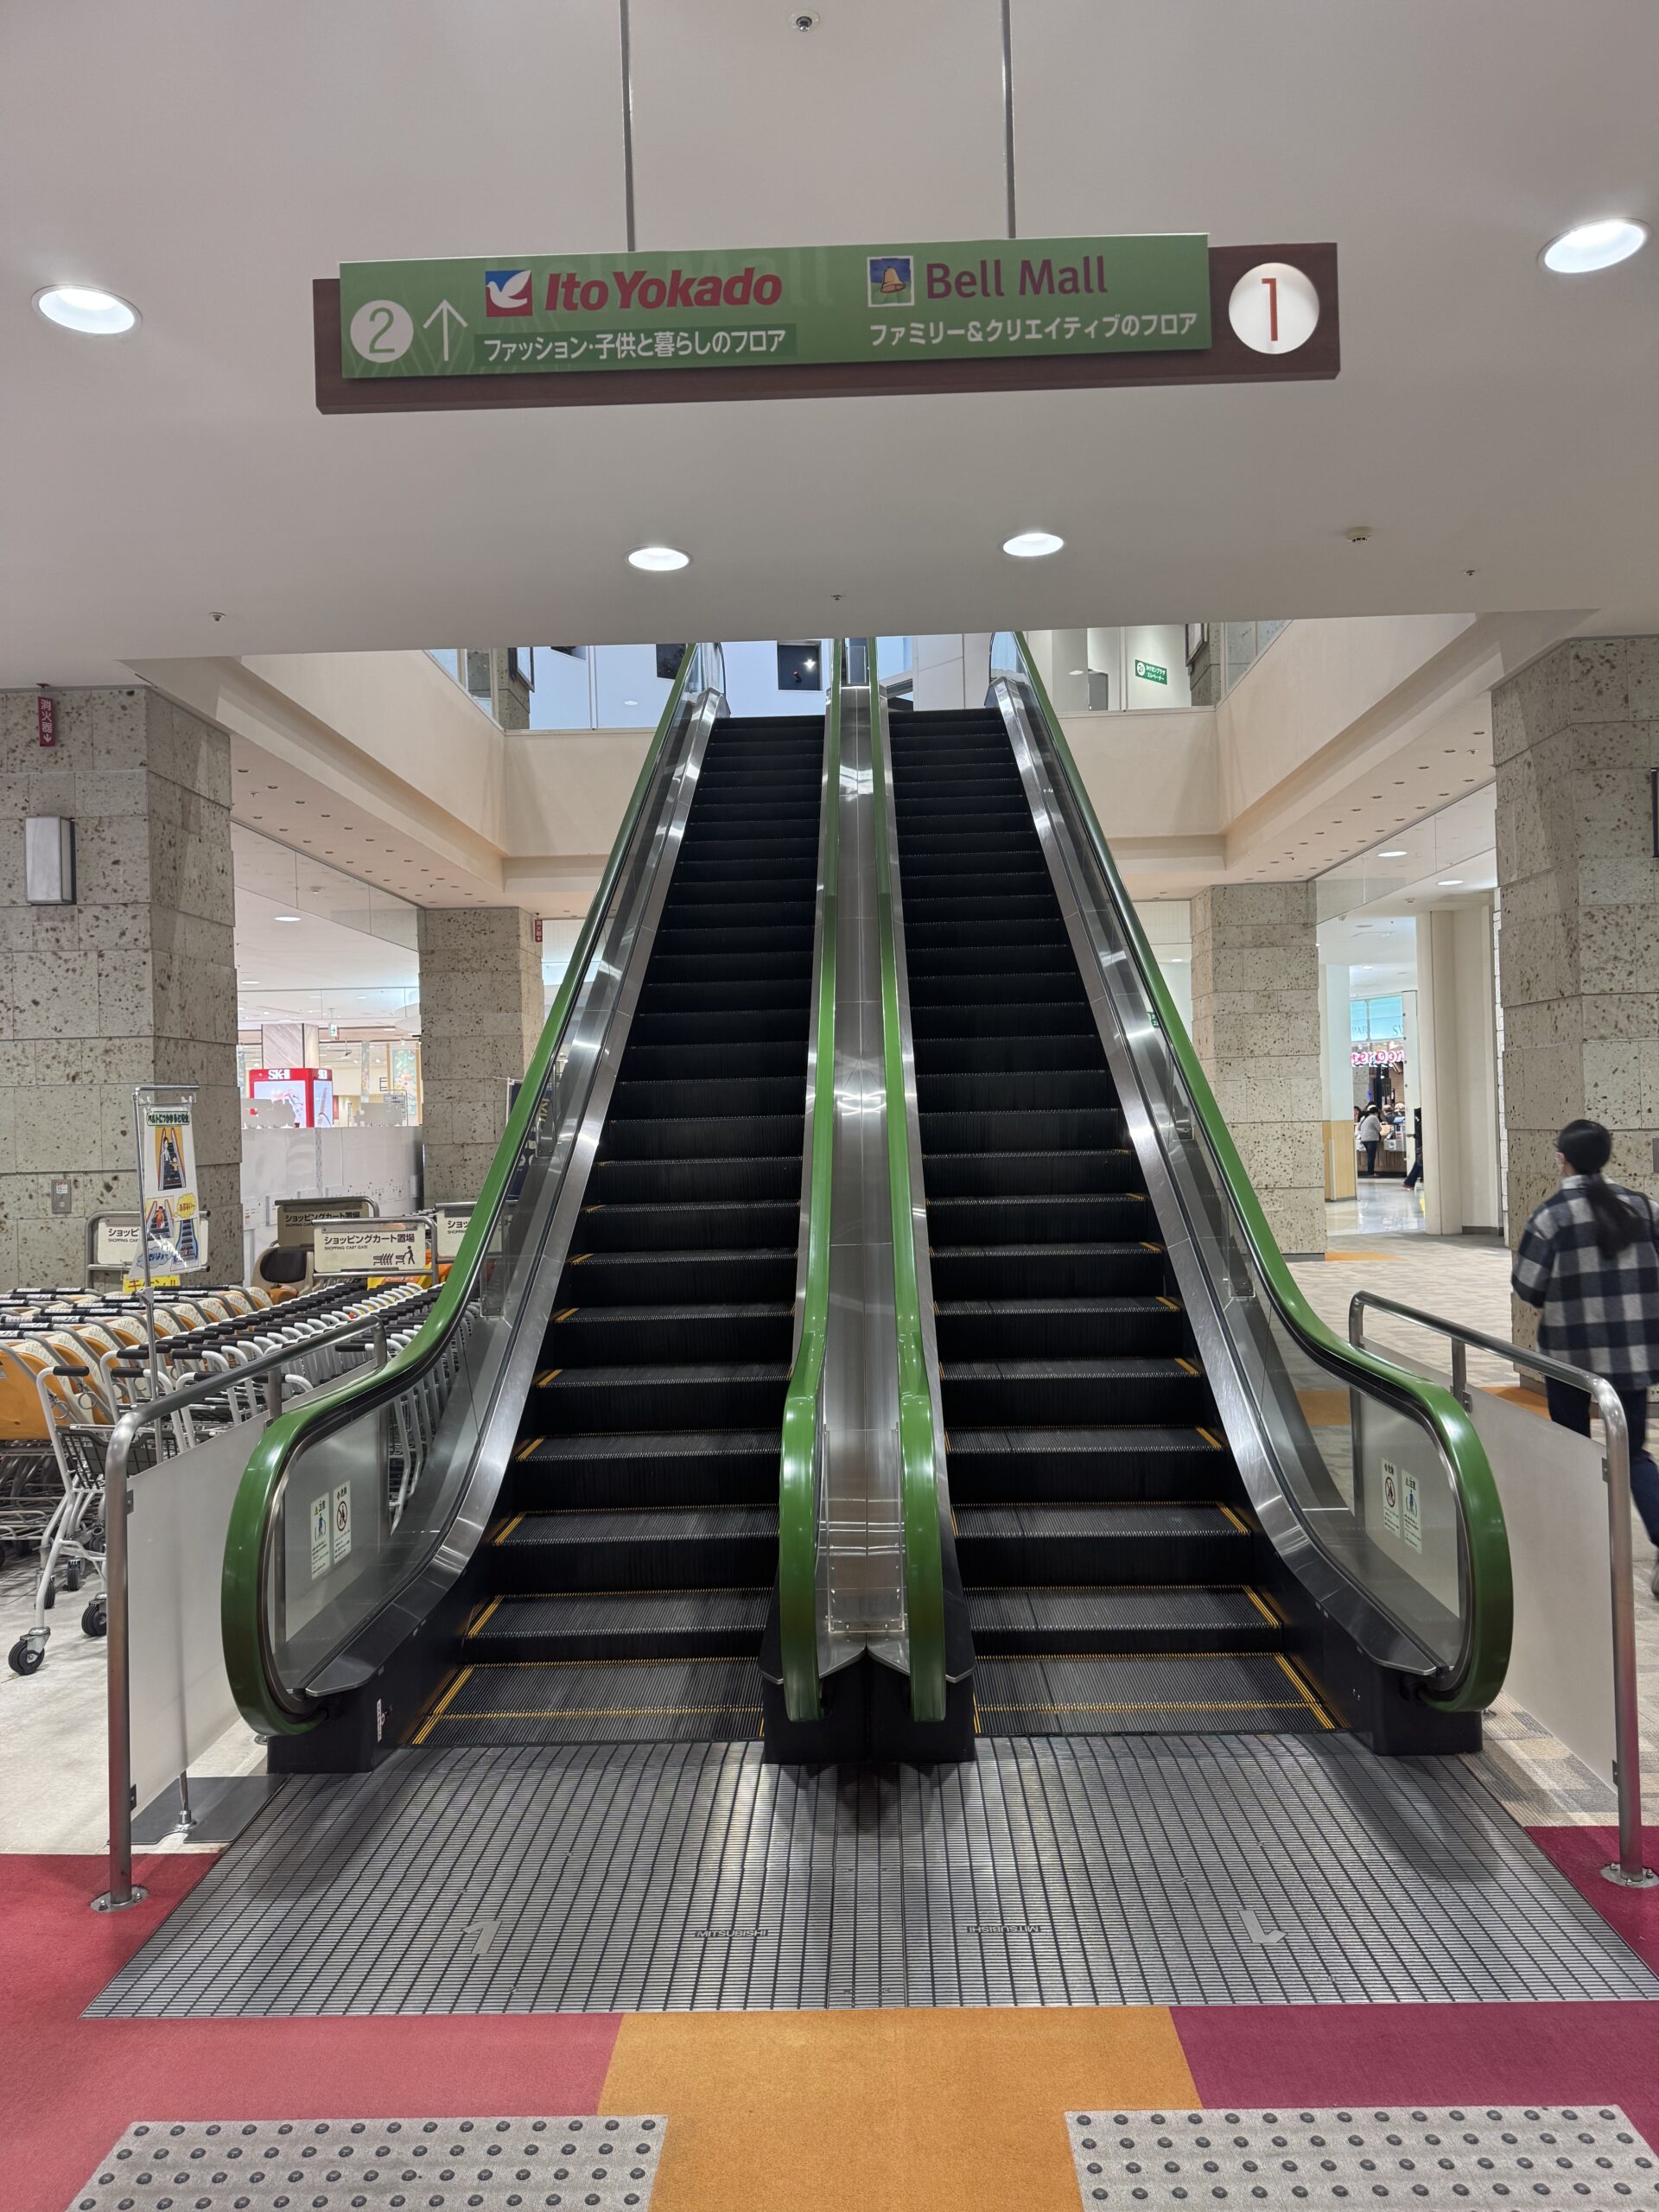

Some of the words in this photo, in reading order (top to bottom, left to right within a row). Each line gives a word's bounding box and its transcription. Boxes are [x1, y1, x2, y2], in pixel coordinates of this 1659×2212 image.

[926, 258, 1005, 299] Bell
[1019, 256, 1108, 296] Mall
[1262, 277, 1279, 341] 1
[368, 306, 397, 354] 2
[484, 329, 785, 362] ファッション・子供と暮らしのフロア
[869, 313, 1198, 346] ファミリー&クリエイティブのフロア
[41, 698, 53, 734] 消火器
[324, 1233, 415, 1245] ショッピングカート置場
[696, 1929, 766, 1937] MITSUBISHI
